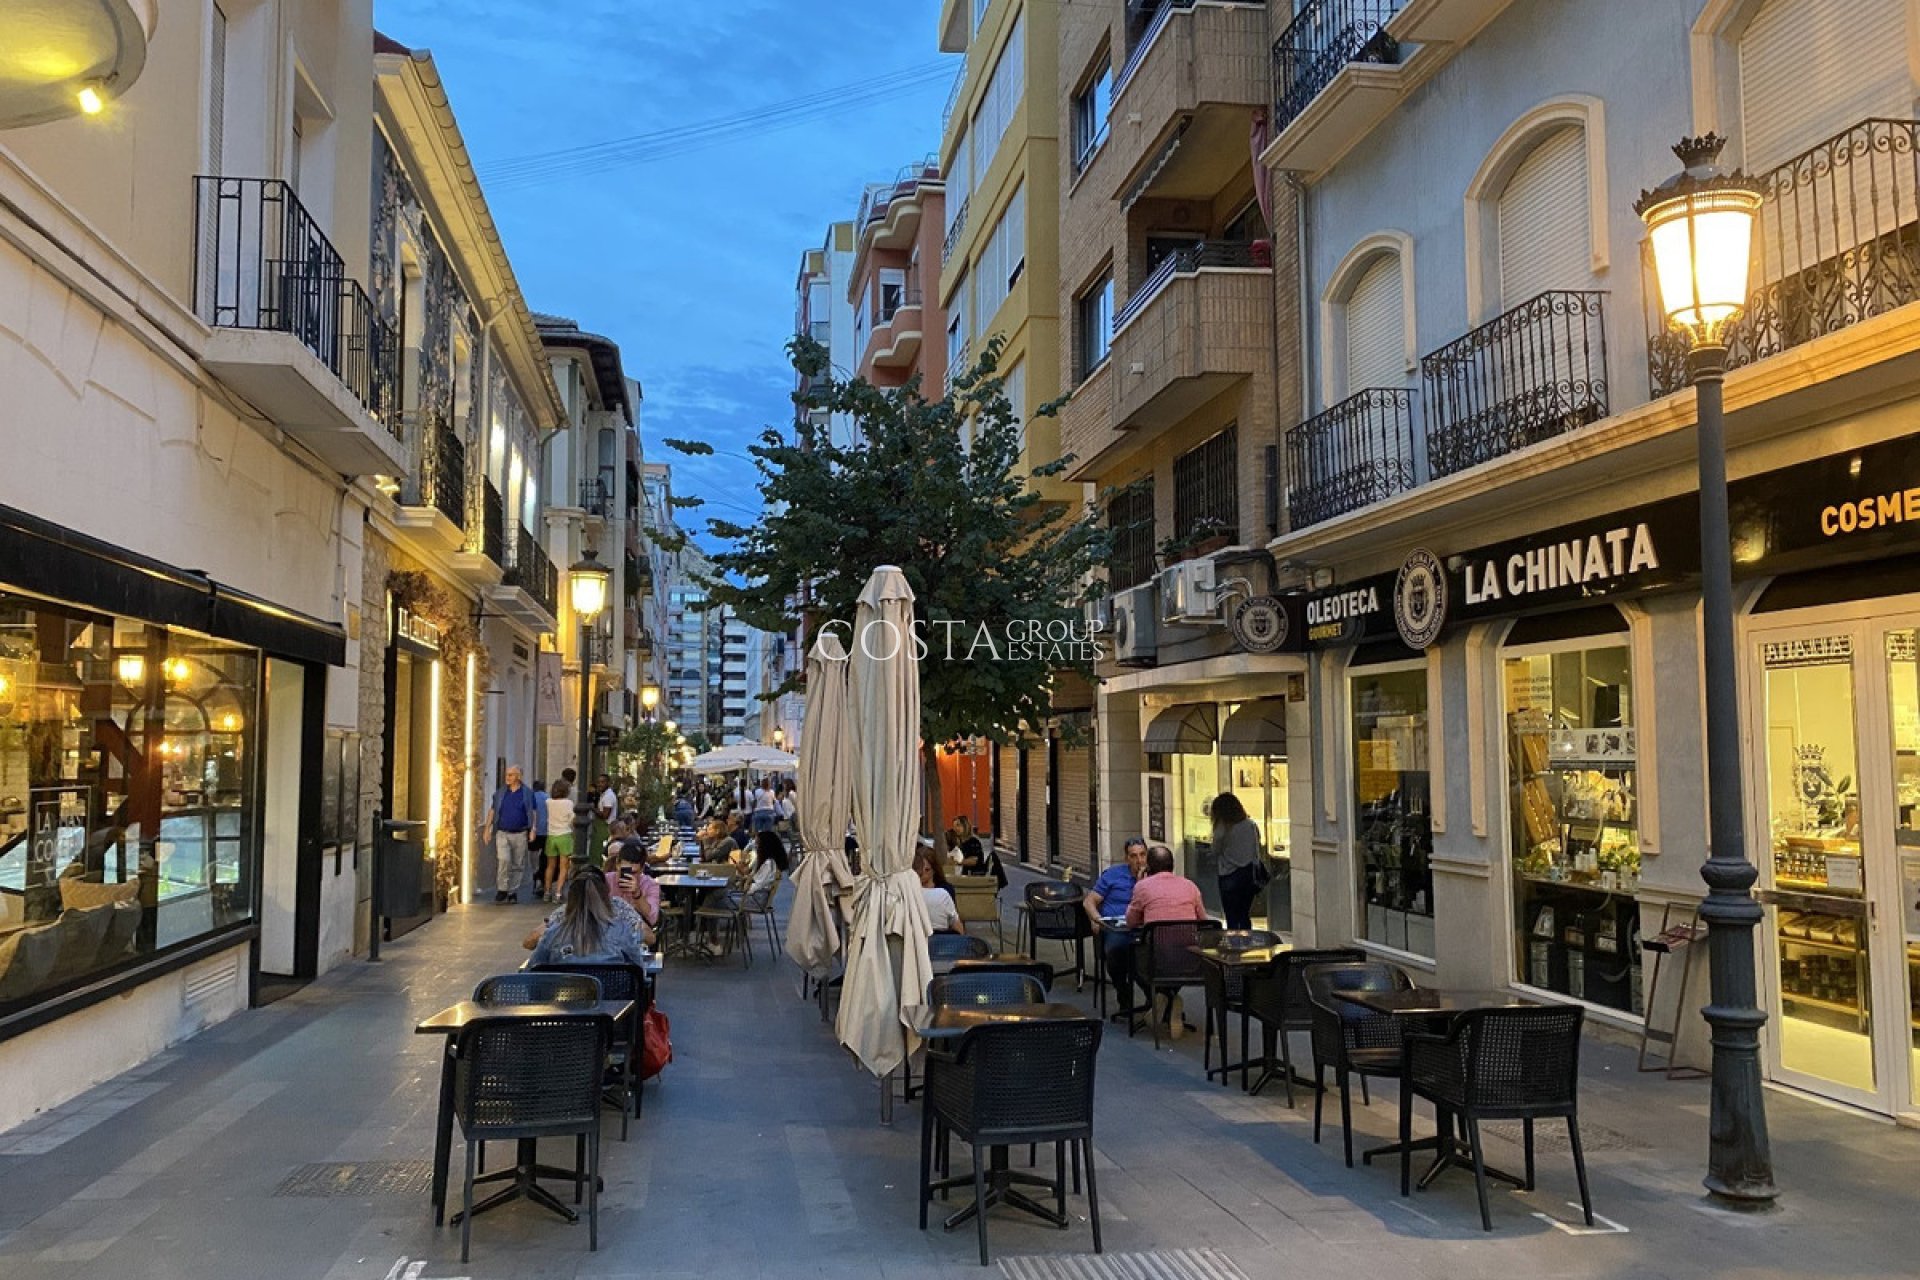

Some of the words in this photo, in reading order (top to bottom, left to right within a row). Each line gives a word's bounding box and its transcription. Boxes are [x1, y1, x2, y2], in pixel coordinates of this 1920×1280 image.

[1821, 487, 1920, 536] COSME
[1465, 560, 1502, 605] LA
[1506, 522, 1660, 596] CHINATA
[1306, 586, 1379, 625] OLEOTECA
[36, 811, 52, 834] LA
